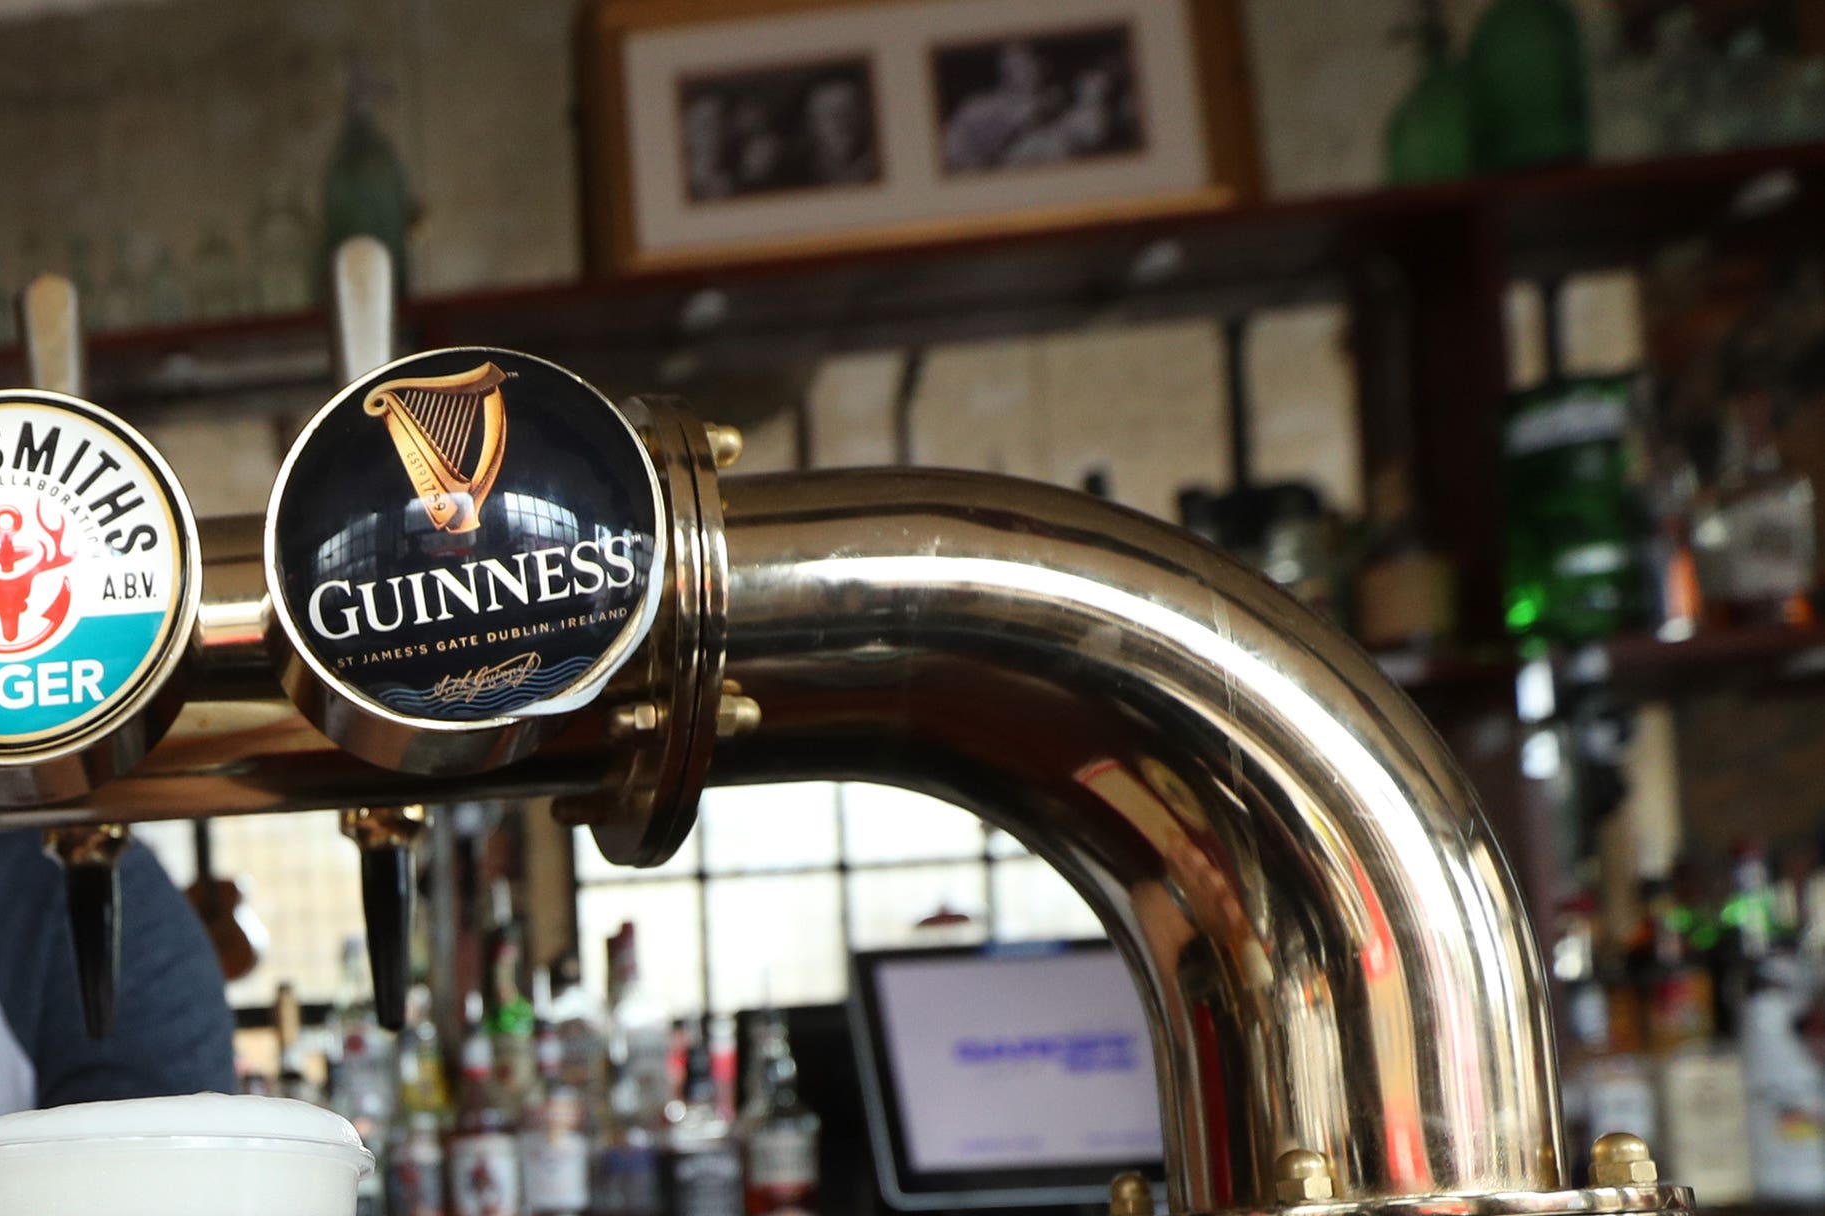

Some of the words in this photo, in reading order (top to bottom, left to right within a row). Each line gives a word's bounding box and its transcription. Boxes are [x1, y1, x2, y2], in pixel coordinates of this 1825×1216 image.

[420, 479, 447, 511] 1759
[102, 571, 157, 600] A.B.V.
[308, 535, 636, 640] GUINNESS
[337, 658, 354, 669] ST
[436, 635, 478, 651] GATE
[561, 607, 628, 629] IRELAND
